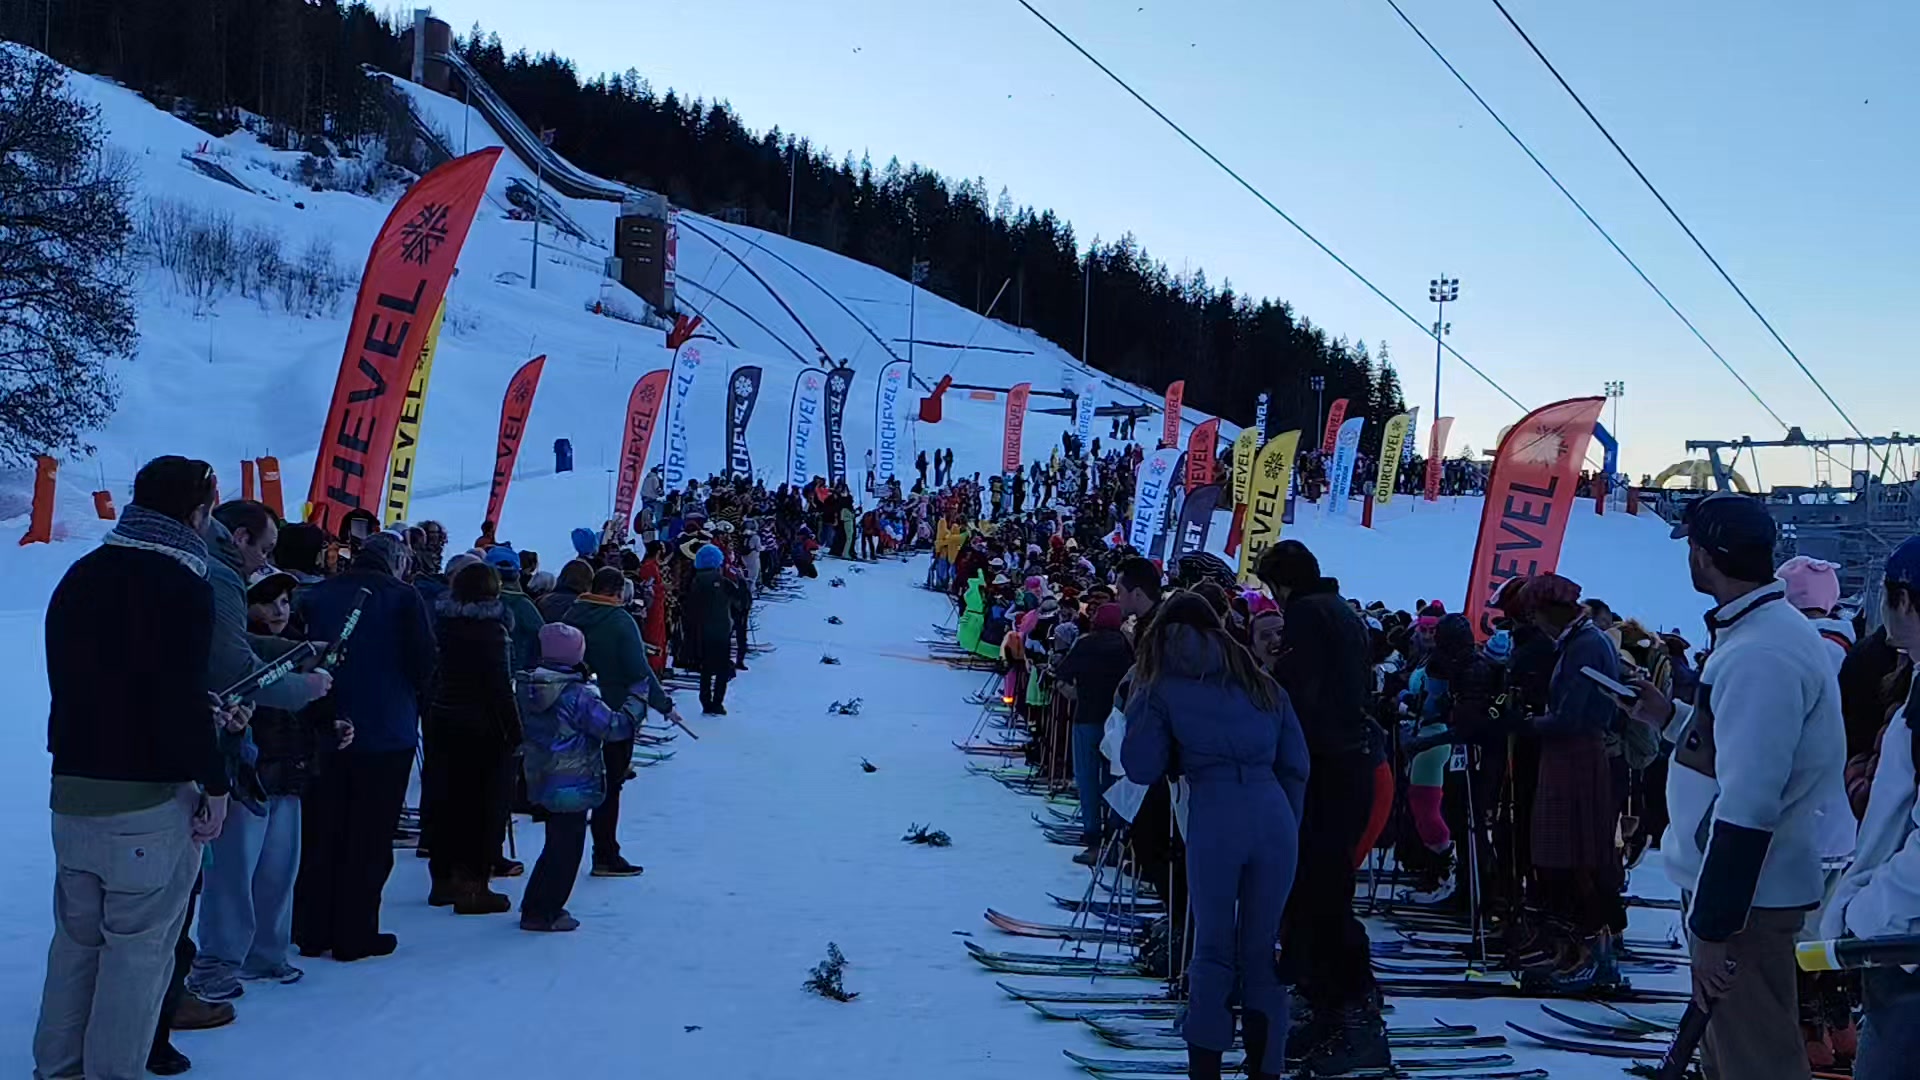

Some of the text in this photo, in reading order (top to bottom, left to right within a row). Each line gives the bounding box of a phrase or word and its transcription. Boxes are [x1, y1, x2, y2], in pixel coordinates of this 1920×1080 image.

[322, 279, 427, 527] HEVEL
[1377, 434, 1400, 503] COURCHEVEL
[1245, 485, 1279, 581] EVEL
